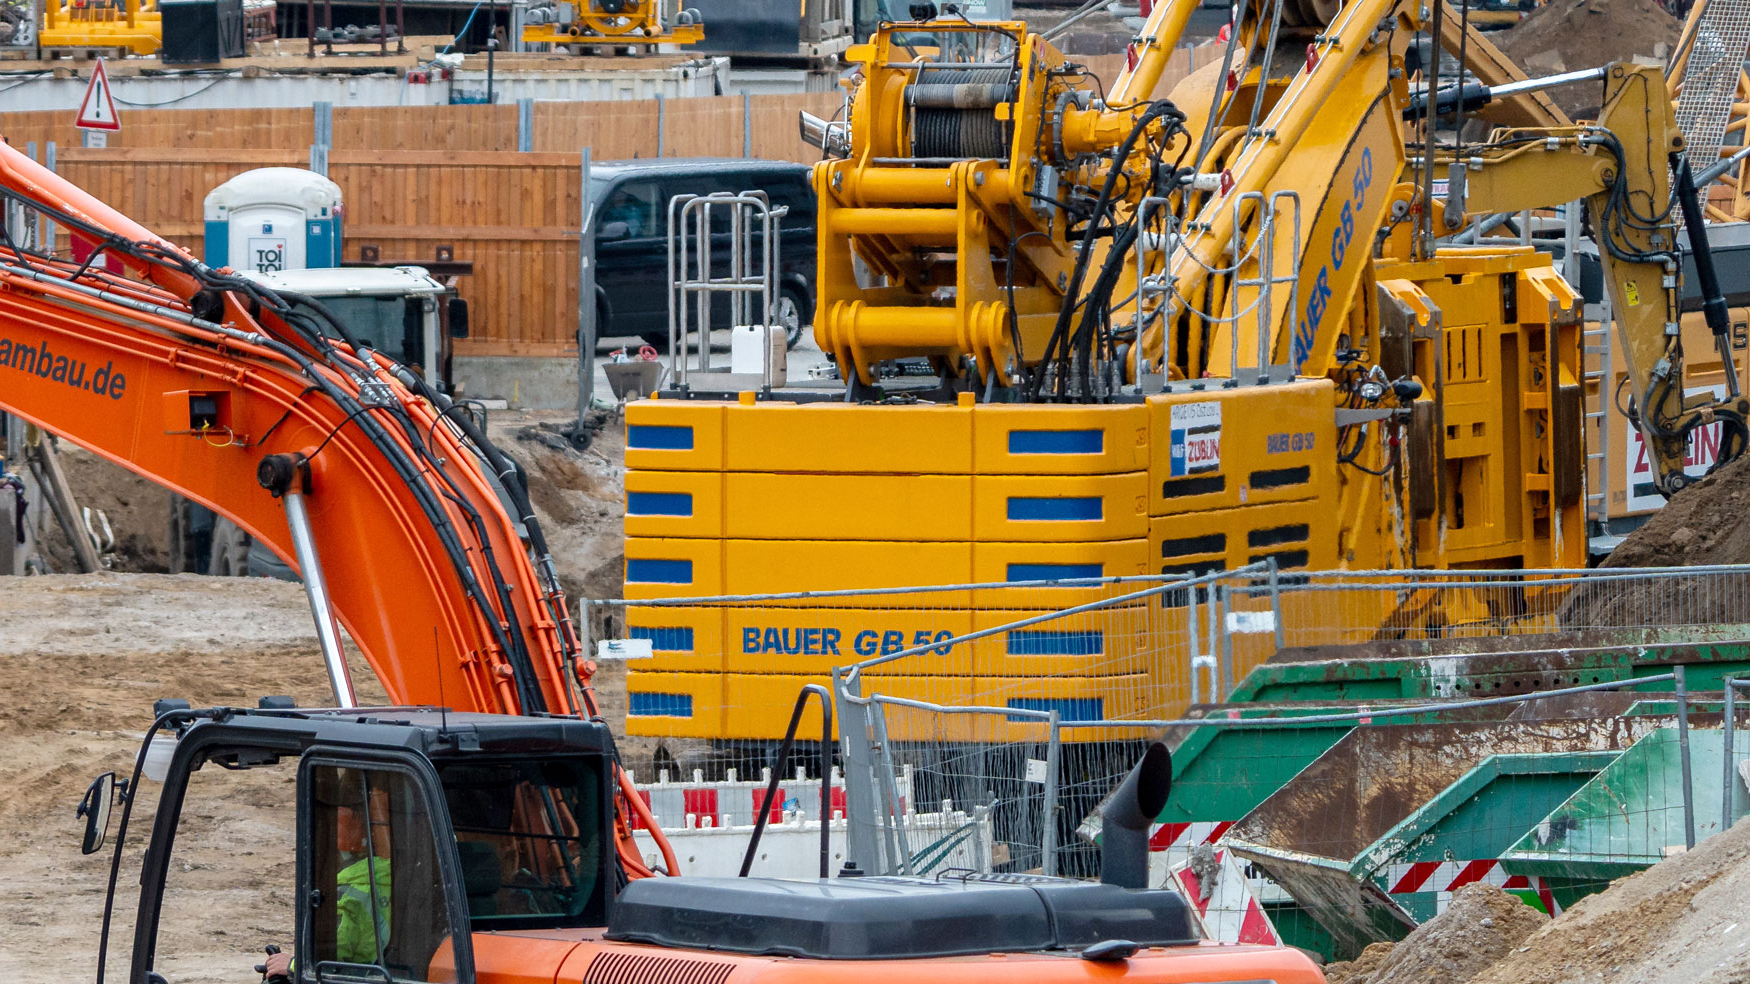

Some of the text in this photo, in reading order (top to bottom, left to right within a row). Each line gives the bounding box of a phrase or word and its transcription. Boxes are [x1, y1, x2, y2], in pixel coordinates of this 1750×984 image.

[1295, 264, 1333, 375] AUER
[742, 627, 954, 656] BAUER GB 50
